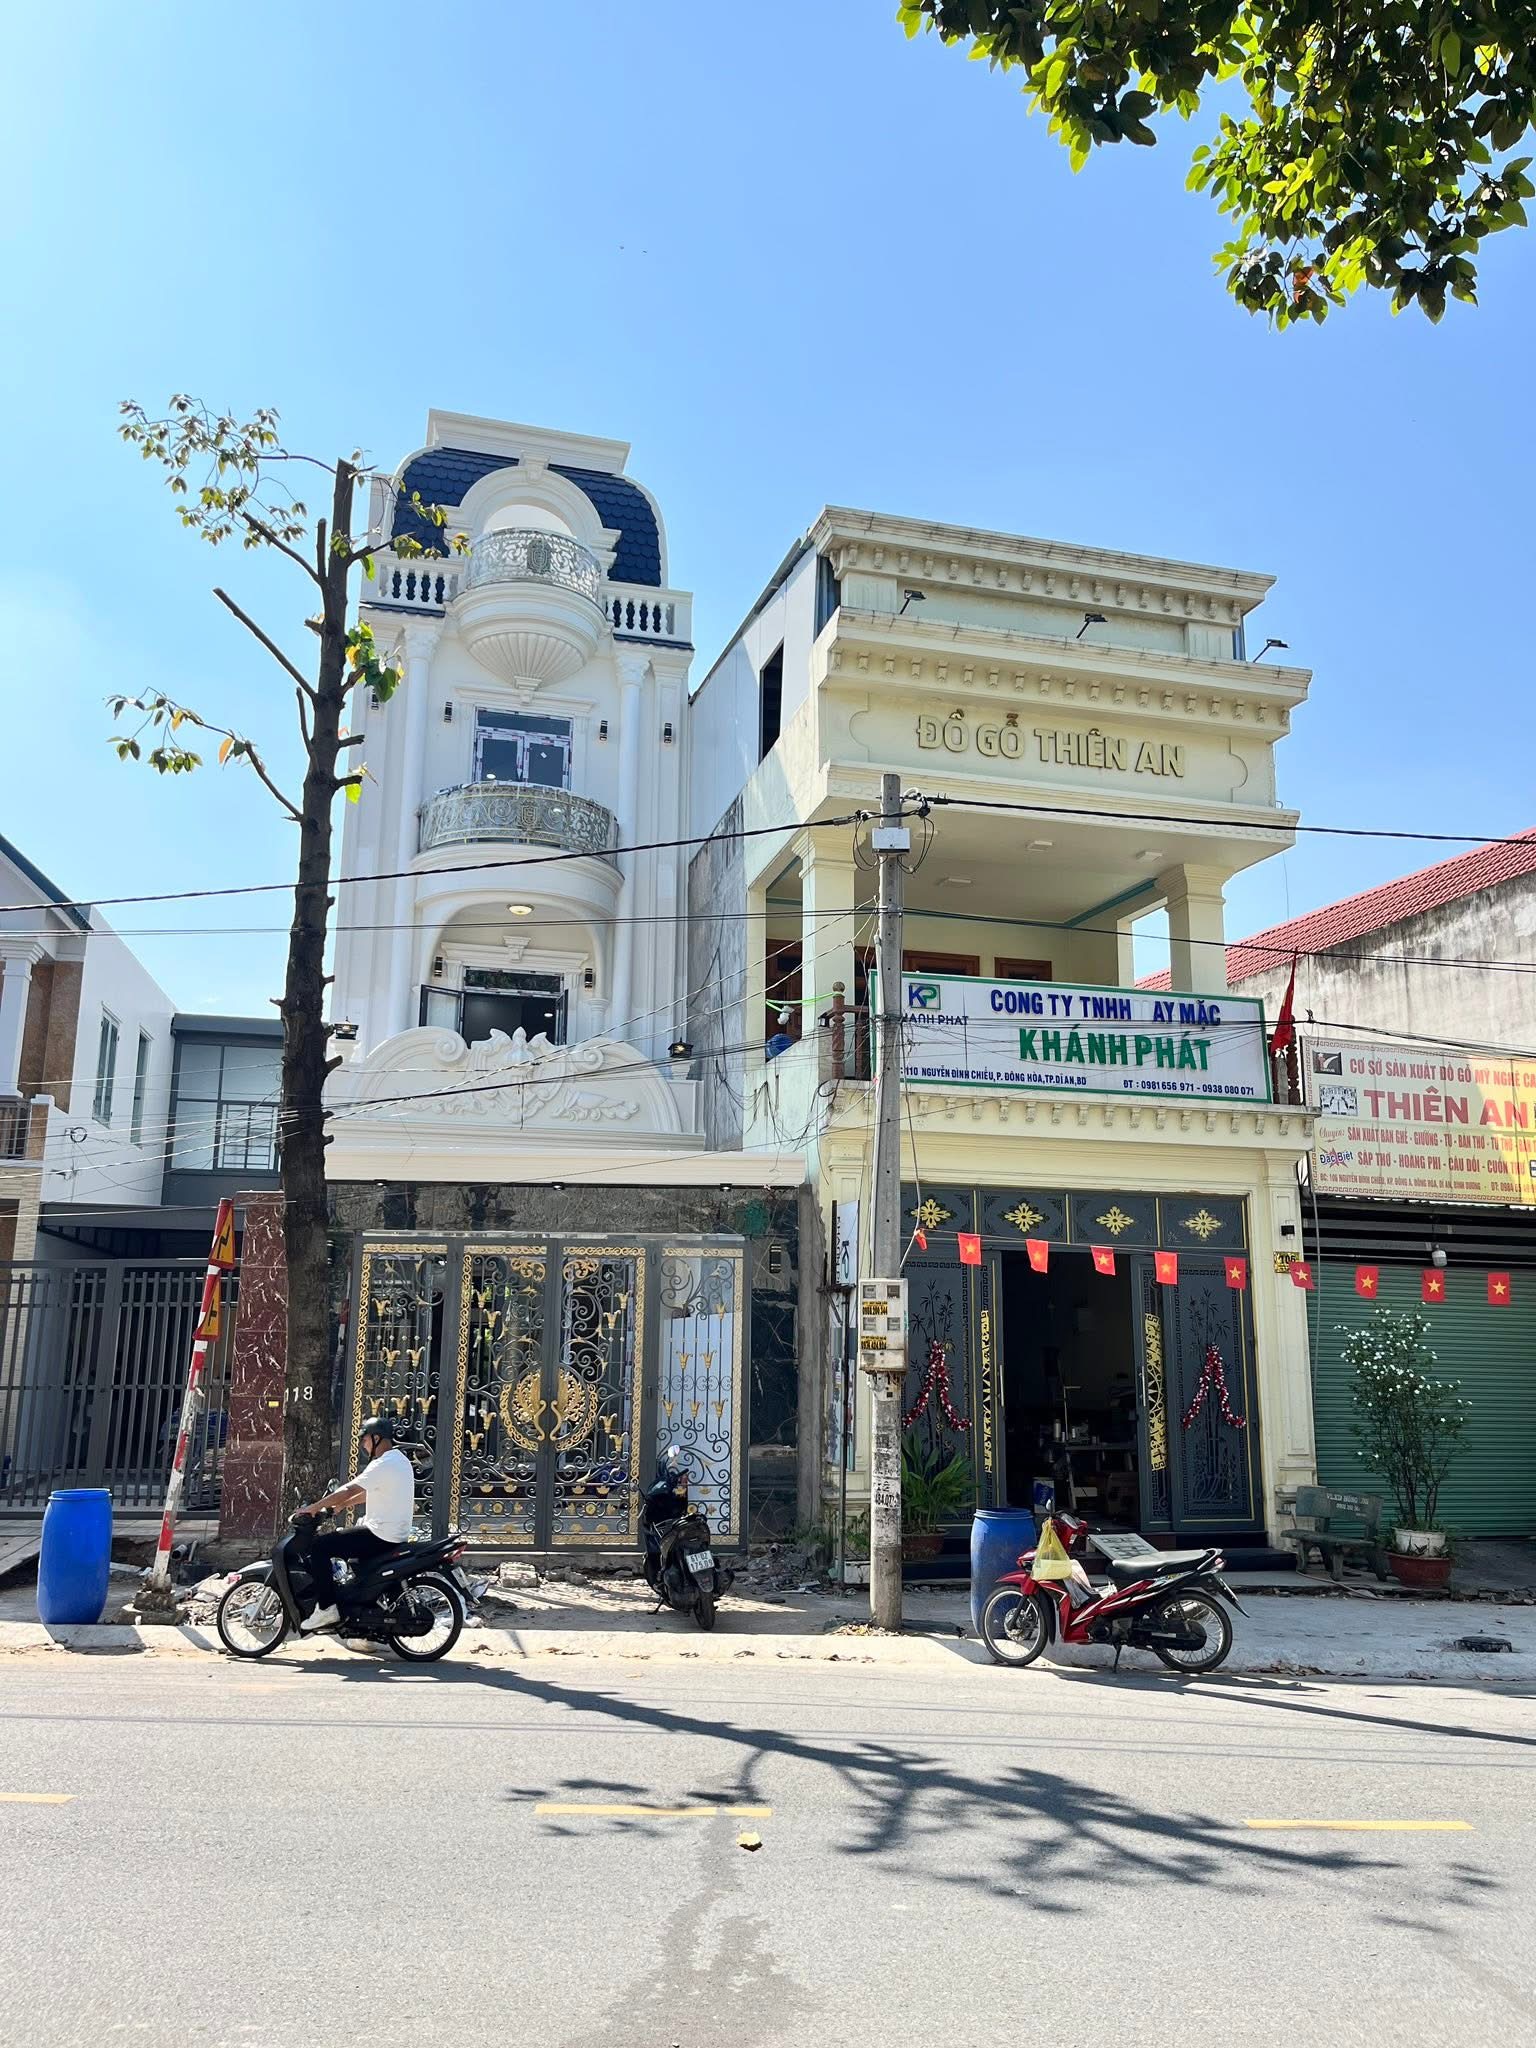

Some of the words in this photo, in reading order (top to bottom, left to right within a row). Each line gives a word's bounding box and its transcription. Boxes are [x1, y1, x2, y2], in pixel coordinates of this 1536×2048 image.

[916, 708, 969, 752] ĐỒ
[976, 713, 1025, 759] GỖ
[1034, 728, 1128, 771] THIÊN
[1135, 741, 1185, 777] AN
[1048, 994, 1073, 1017] TY
[1079, 996, 1132, 1020] TNHH
[1179, 999, 1221, 1029] MẶC
[1019, 1024, 1129, 1066] KHÁNH
[1134, 1031, 1211, 1070] PHÁT
[921, 1065, 950, 1078] NGUYỄN
[951, 1067, 969, 1079] ĐÌNH
[1004, 1070, 1025, 1081] ĐÔNG
[1350, 1057, 1365, 1075] CƠ
[1368, 1057, 1383, 1076] SỞ
[1385, 1058, 1407, 1078] SẢN
[1409, 1060, 1437, 1080] XUẤT
[1439, 1061, 1454, 1082] ĐỒ
[1457, 1064, 1472, 1083] GỖ
[1141, 1080, 1160, 1090] 0981
[1161, 1081, 1177, 1091] 656
[1179, 1083, 1194, 1092] 971
[1202, 1083, 1223, 1093] 0938
[1224, 1085, 1239, 1095] 080
[1240, 1086, 1254, 1096] 071
[1363, 1085, 1470, 1124] THIÊN
[1479, 1098, 1529, 1129] AN
[1362, 1124, 1379, 1142] XUẤT
[1427, 1155, 1441, 1170] PHI
